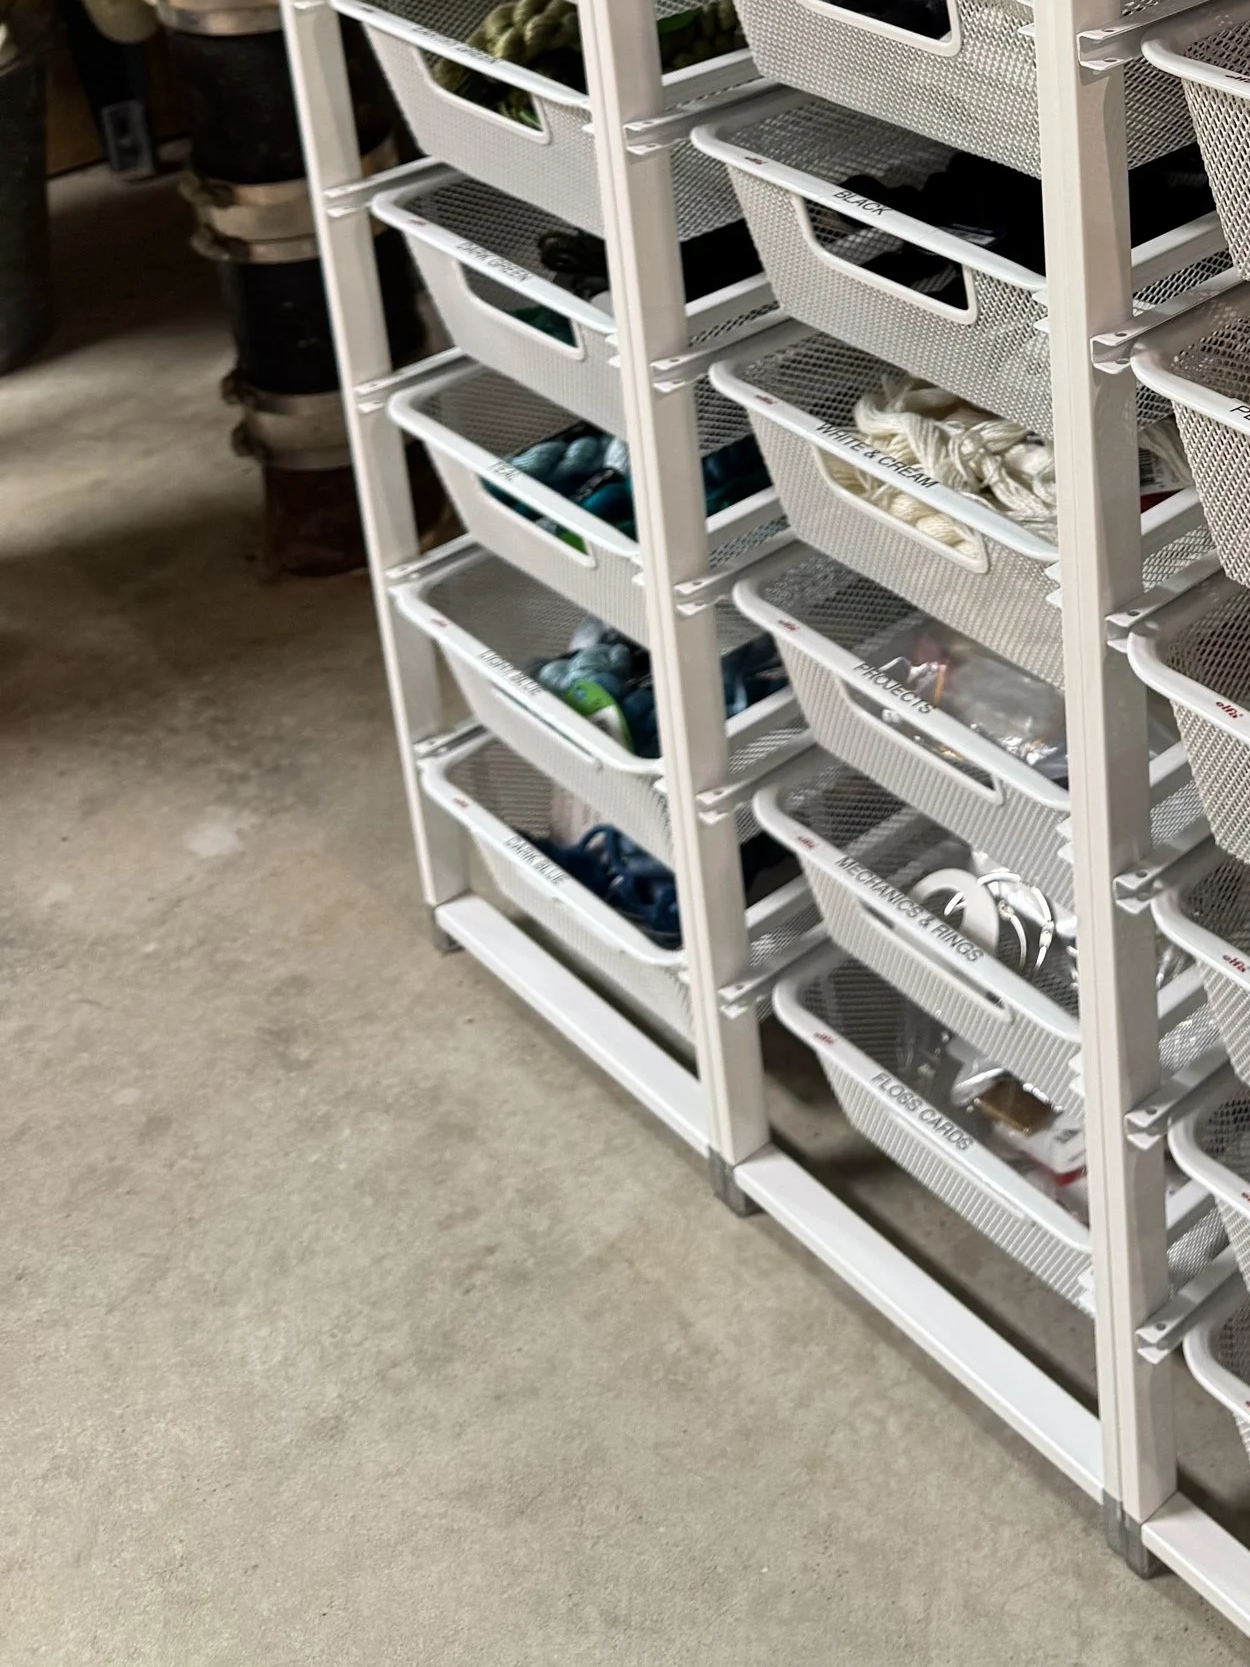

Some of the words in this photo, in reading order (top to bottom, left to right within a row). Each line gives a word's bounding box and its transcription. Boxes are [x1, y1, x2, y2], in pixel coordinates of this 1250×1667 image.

[833, 189, 893, 216] BLACK
[815, 422, 871, 452] WHITE
[863, 448, 880, 459] &
[878, 454, 941, 488] CREAM
[853, 663, 934, 714] PROJECTS
[835, 855, 922, 918] MECHANICS
[918, 912, 932, 928] &
[931, 920, 985, 962] RINGS
[871, 1071, 923, 1112] FLOSS
[918, 1107, 974, 1151] CARDS
